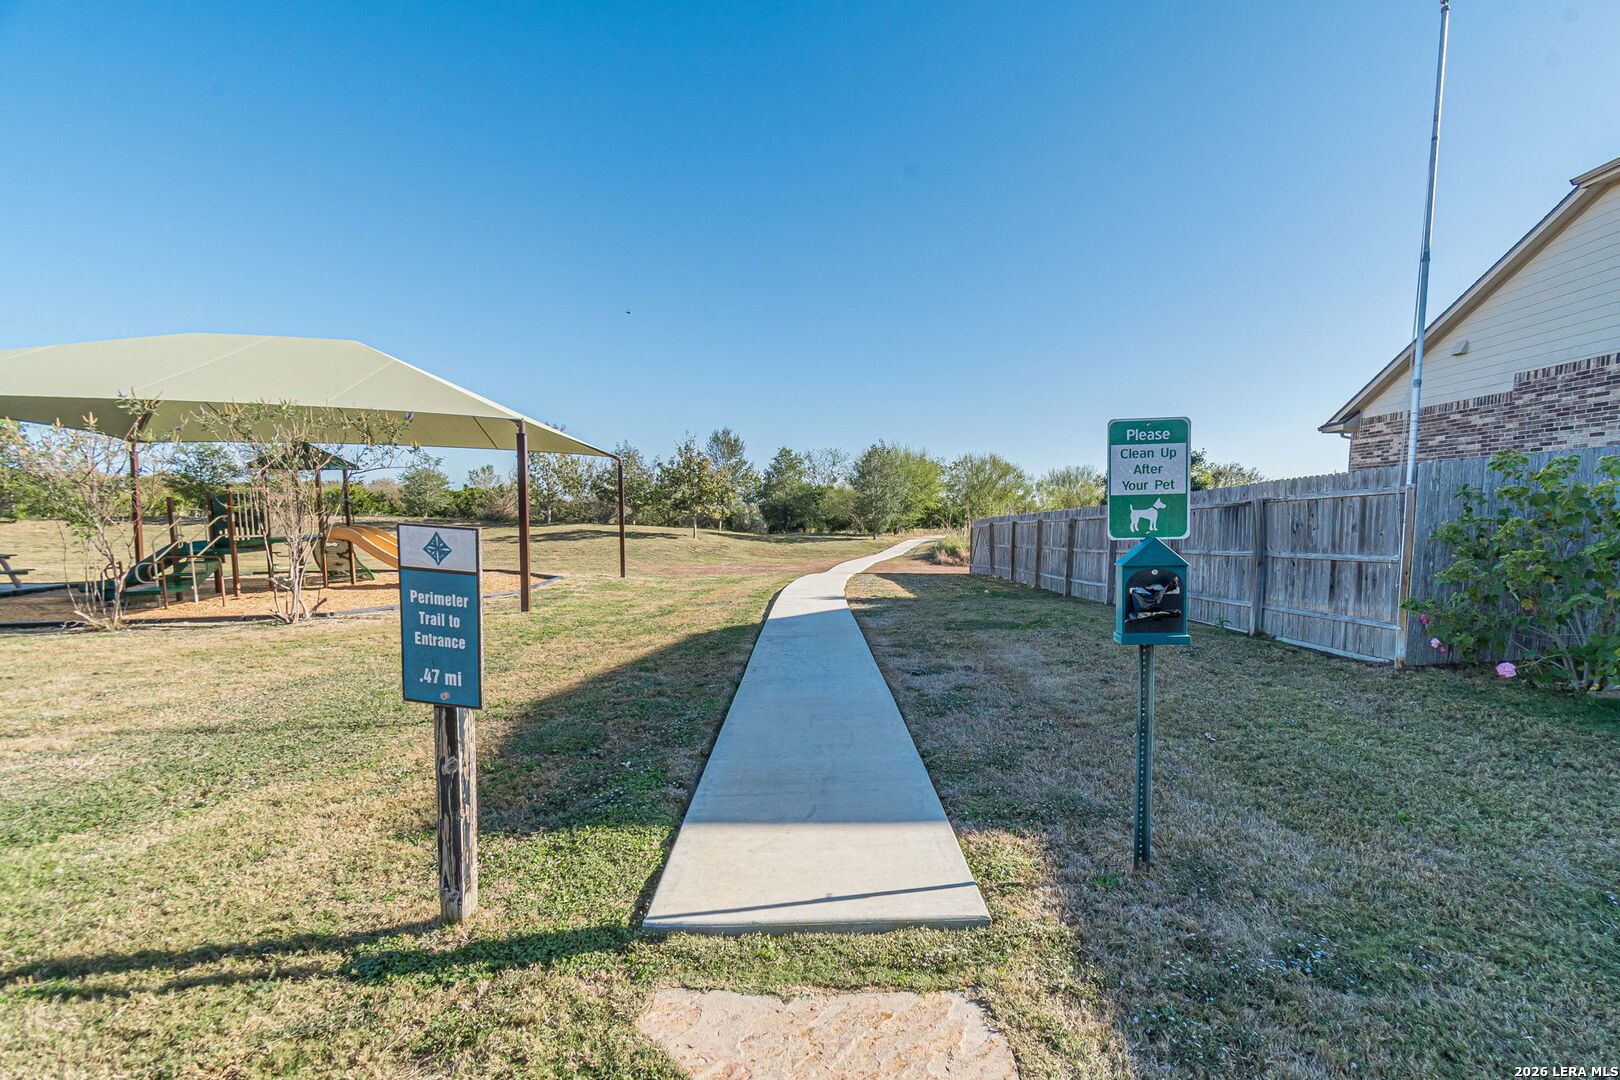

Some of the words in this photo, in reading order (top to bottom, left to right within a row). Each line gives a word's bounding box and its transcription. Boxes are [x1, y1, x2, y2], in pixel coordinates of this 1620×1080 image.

[1126, 429, 1170, 440] Please
[1120, 448, 1154, 458] Clean
[1161, 448, 1176, 460] Up
[1134, 464, 1163, 474] After
[1122, 481, 1148, 490] Your
[1155, 480, 1175, 490] Pet
[410, 590, 468, 608] Perimeter
[418, 611, 445, 626] Trail
[448, 614, 460, 628] to
[414, 632, 466, 650] Entrance
[420, 668, 440, 684] .47
[444, 672, 462, 686] mi
